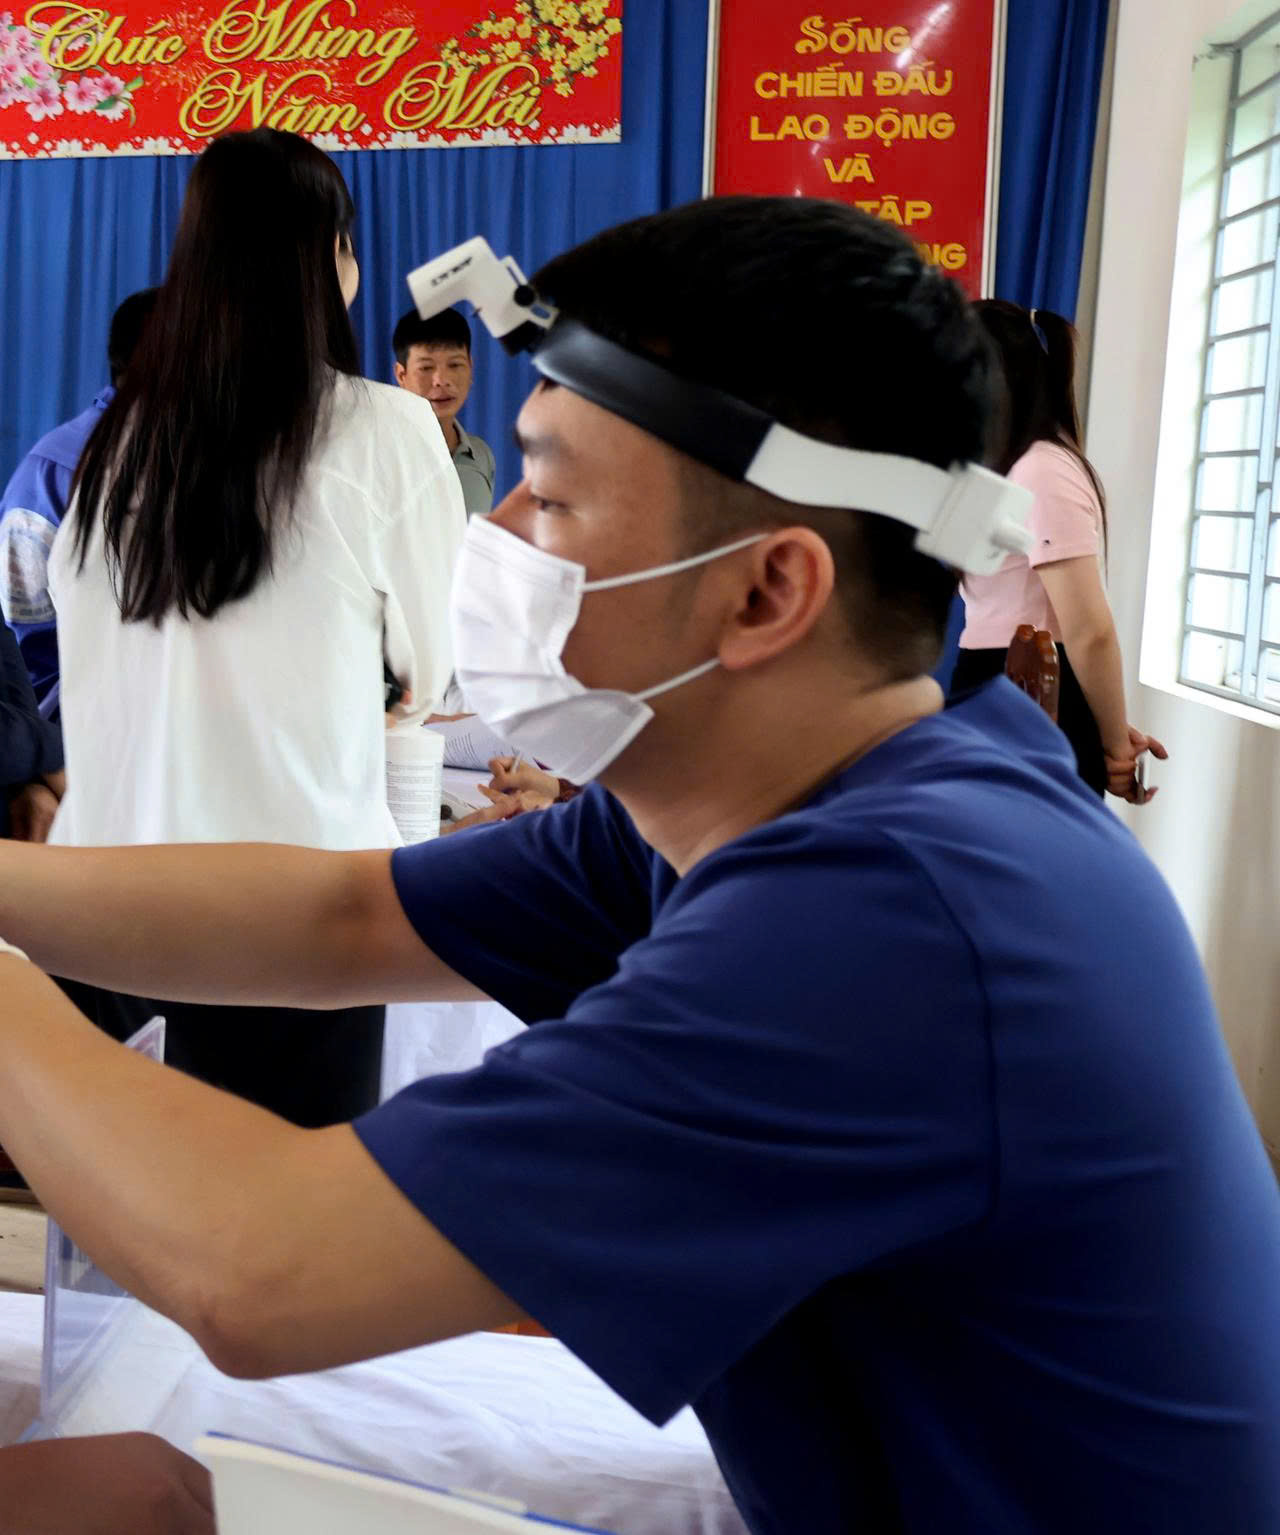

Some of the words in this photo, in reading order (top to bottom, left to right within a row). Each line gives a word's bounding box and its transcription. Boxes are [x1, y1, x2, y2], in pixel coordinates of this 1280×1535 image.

[24, 0, 187, 72] Chúc
[203, 0, 419, 87] Mừng
[794, 15, 913, 54] SỐNG
[179, 68, 367, 137] Năm
[383, 61, 544, 131] Mới
[754, 61, 863, 99] CHIẾN
[872, 60, 953, 96] ĐẤU
[750, 114, 830, 141] LAO
[843, 107, 956, 147] ĐỘNG
[823, 153, 875, 183] VÀ
